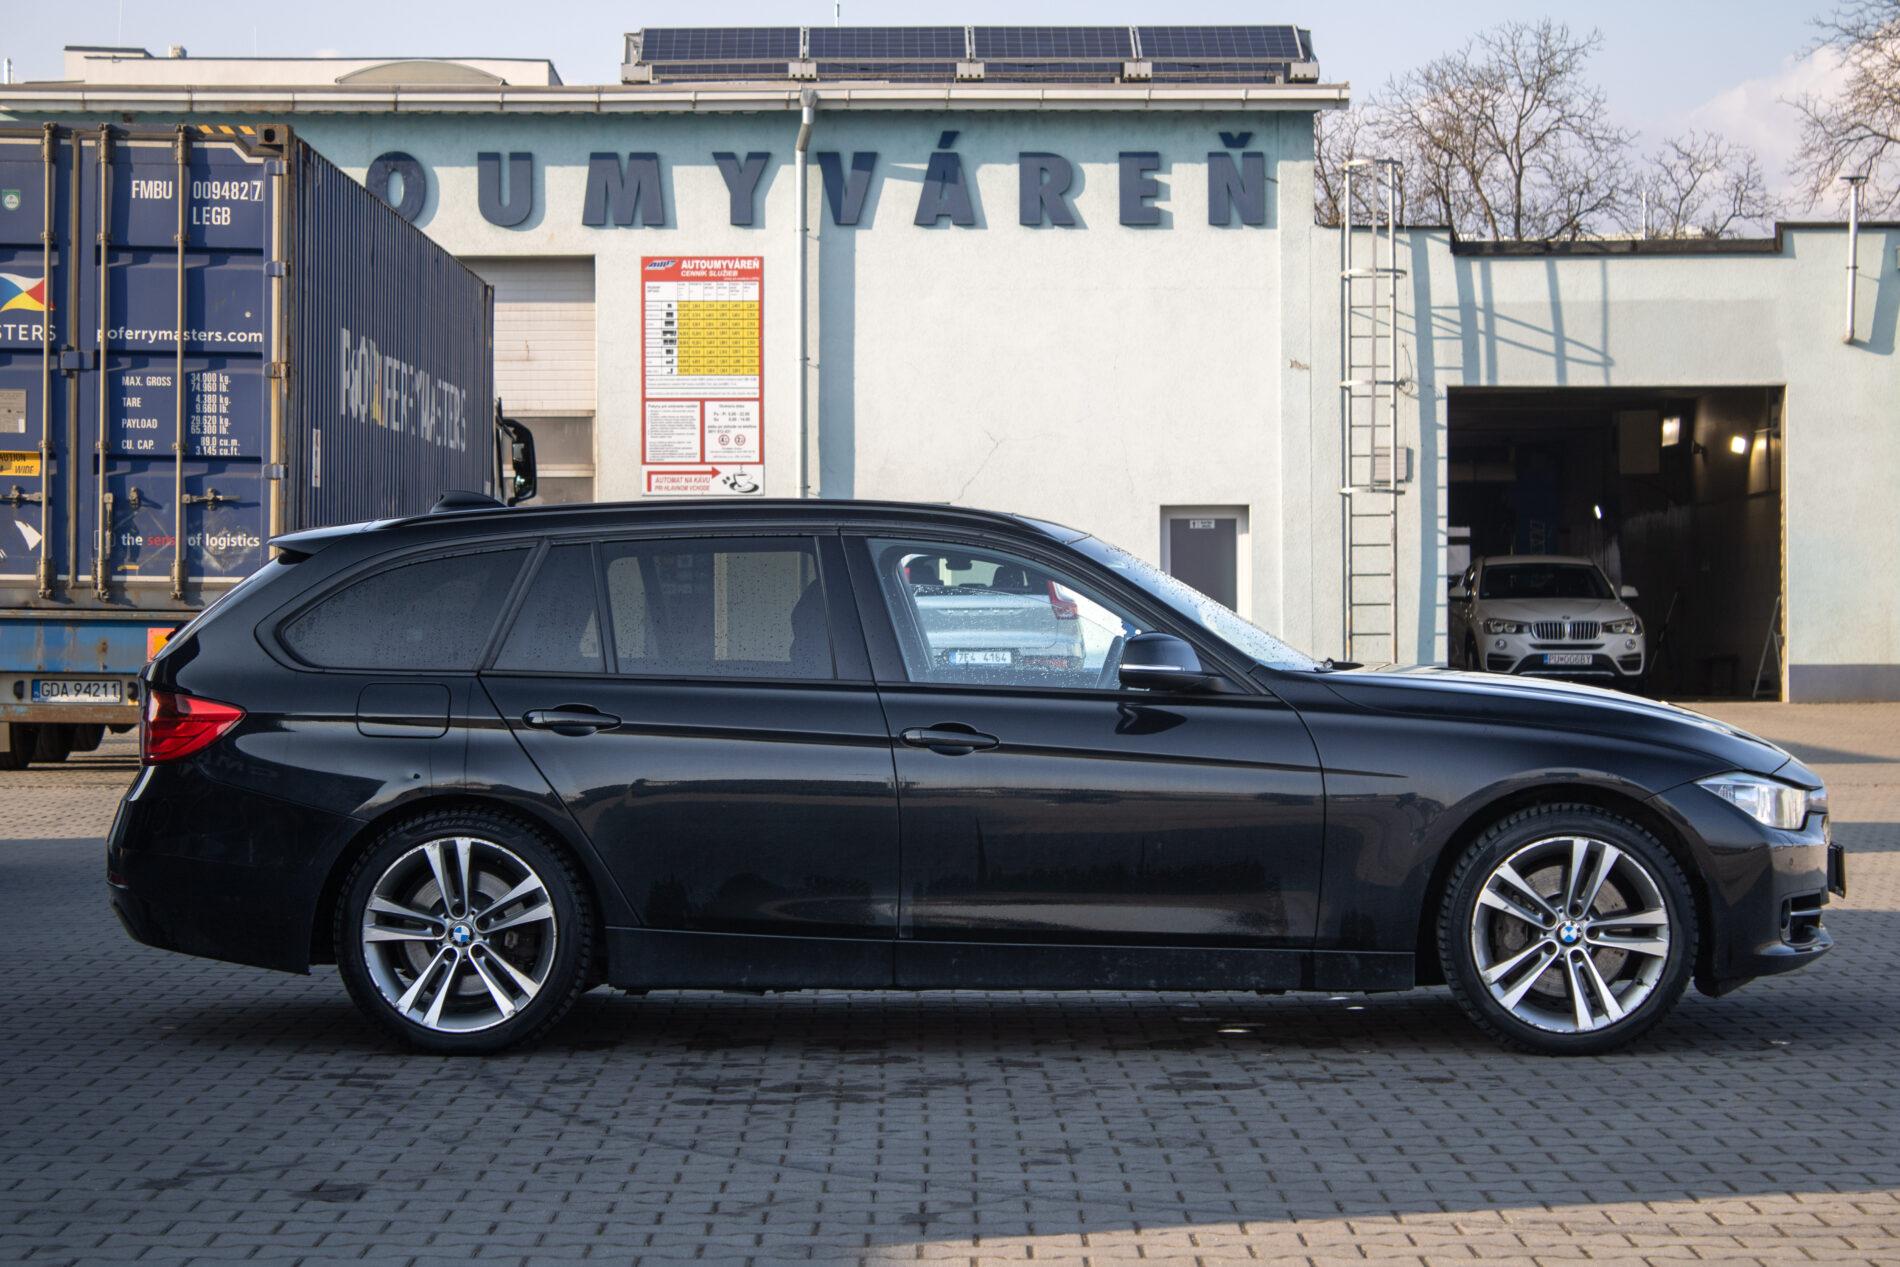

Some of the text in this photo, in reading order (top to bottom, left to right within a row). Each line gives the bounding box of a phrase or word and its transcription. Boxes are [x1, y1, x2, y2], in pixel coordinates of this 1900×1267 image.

[131, 180, 173, 199] FMBU
[193, 206, 231, 225] LEGB
[681, 258, 760, 269] AUTOUMYVÁREŇ
[0, 324, 56, 341] TERS
[96, 326, 263, 344] poferrymasters.com
[122, 376, 172, 387] MAX. GROSS
[191, 372, 231, 385] 34.000 kg.
[219, 382, 229, 392] lb.
[122, 397, 142, 408] TARE
[219, 394, 231, 406] kg.
[219, 403, 229, 413] lb.
[122, 418, 158, 429] PAYLOAD
[219, 415, 231, 427] kg.
[219, 424, 229, 434] lb.
[122, 439, 155, 450] CU. CAP.
[121, 533, 143, 546] the
[188, 533, 202, 546] of
[205, 533, 260, 550] logistics
[41, 682, 117, 697] GDA 94211
